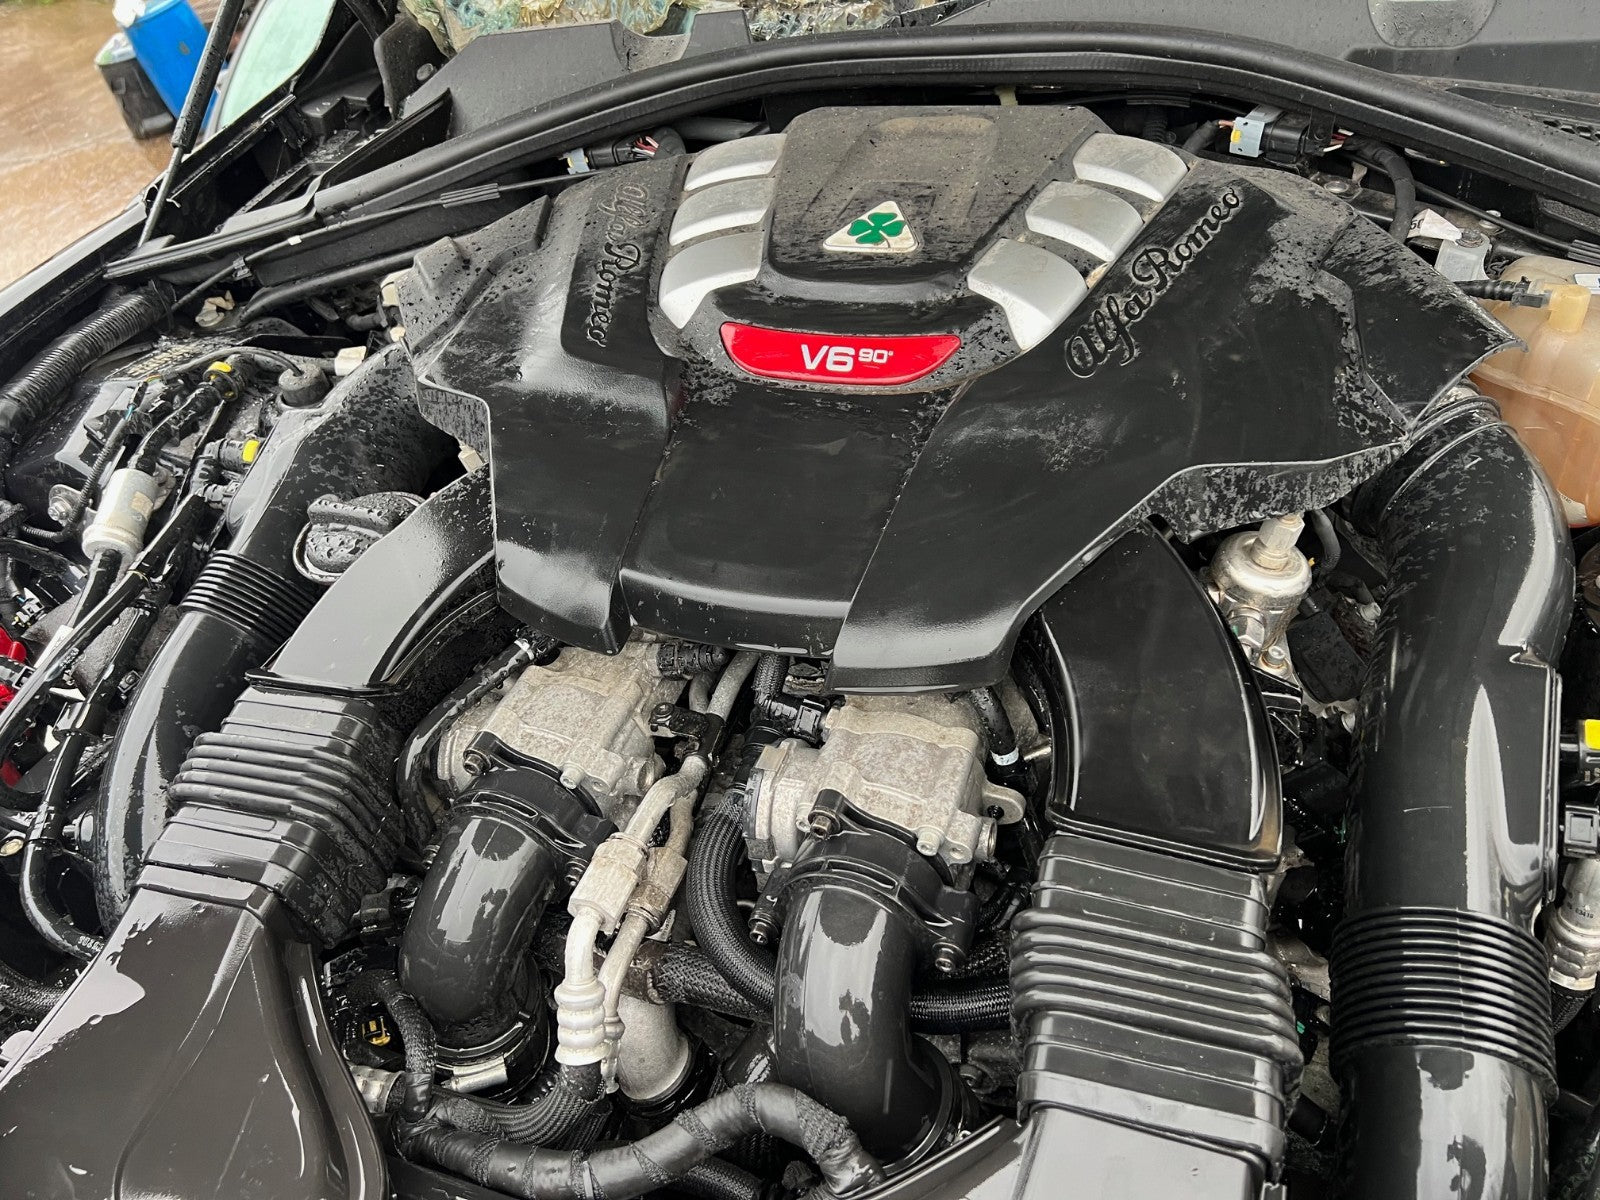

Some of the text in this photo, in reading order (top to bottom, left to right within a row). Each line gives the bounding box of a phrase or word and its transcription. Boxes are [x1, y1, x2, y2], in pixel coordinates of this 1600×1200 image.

[587, 182, 649, 347] Alfa Romeo
[1064, 187, 1240, 378] Alfa Romeo
[800, 343, 856, 373] V6
